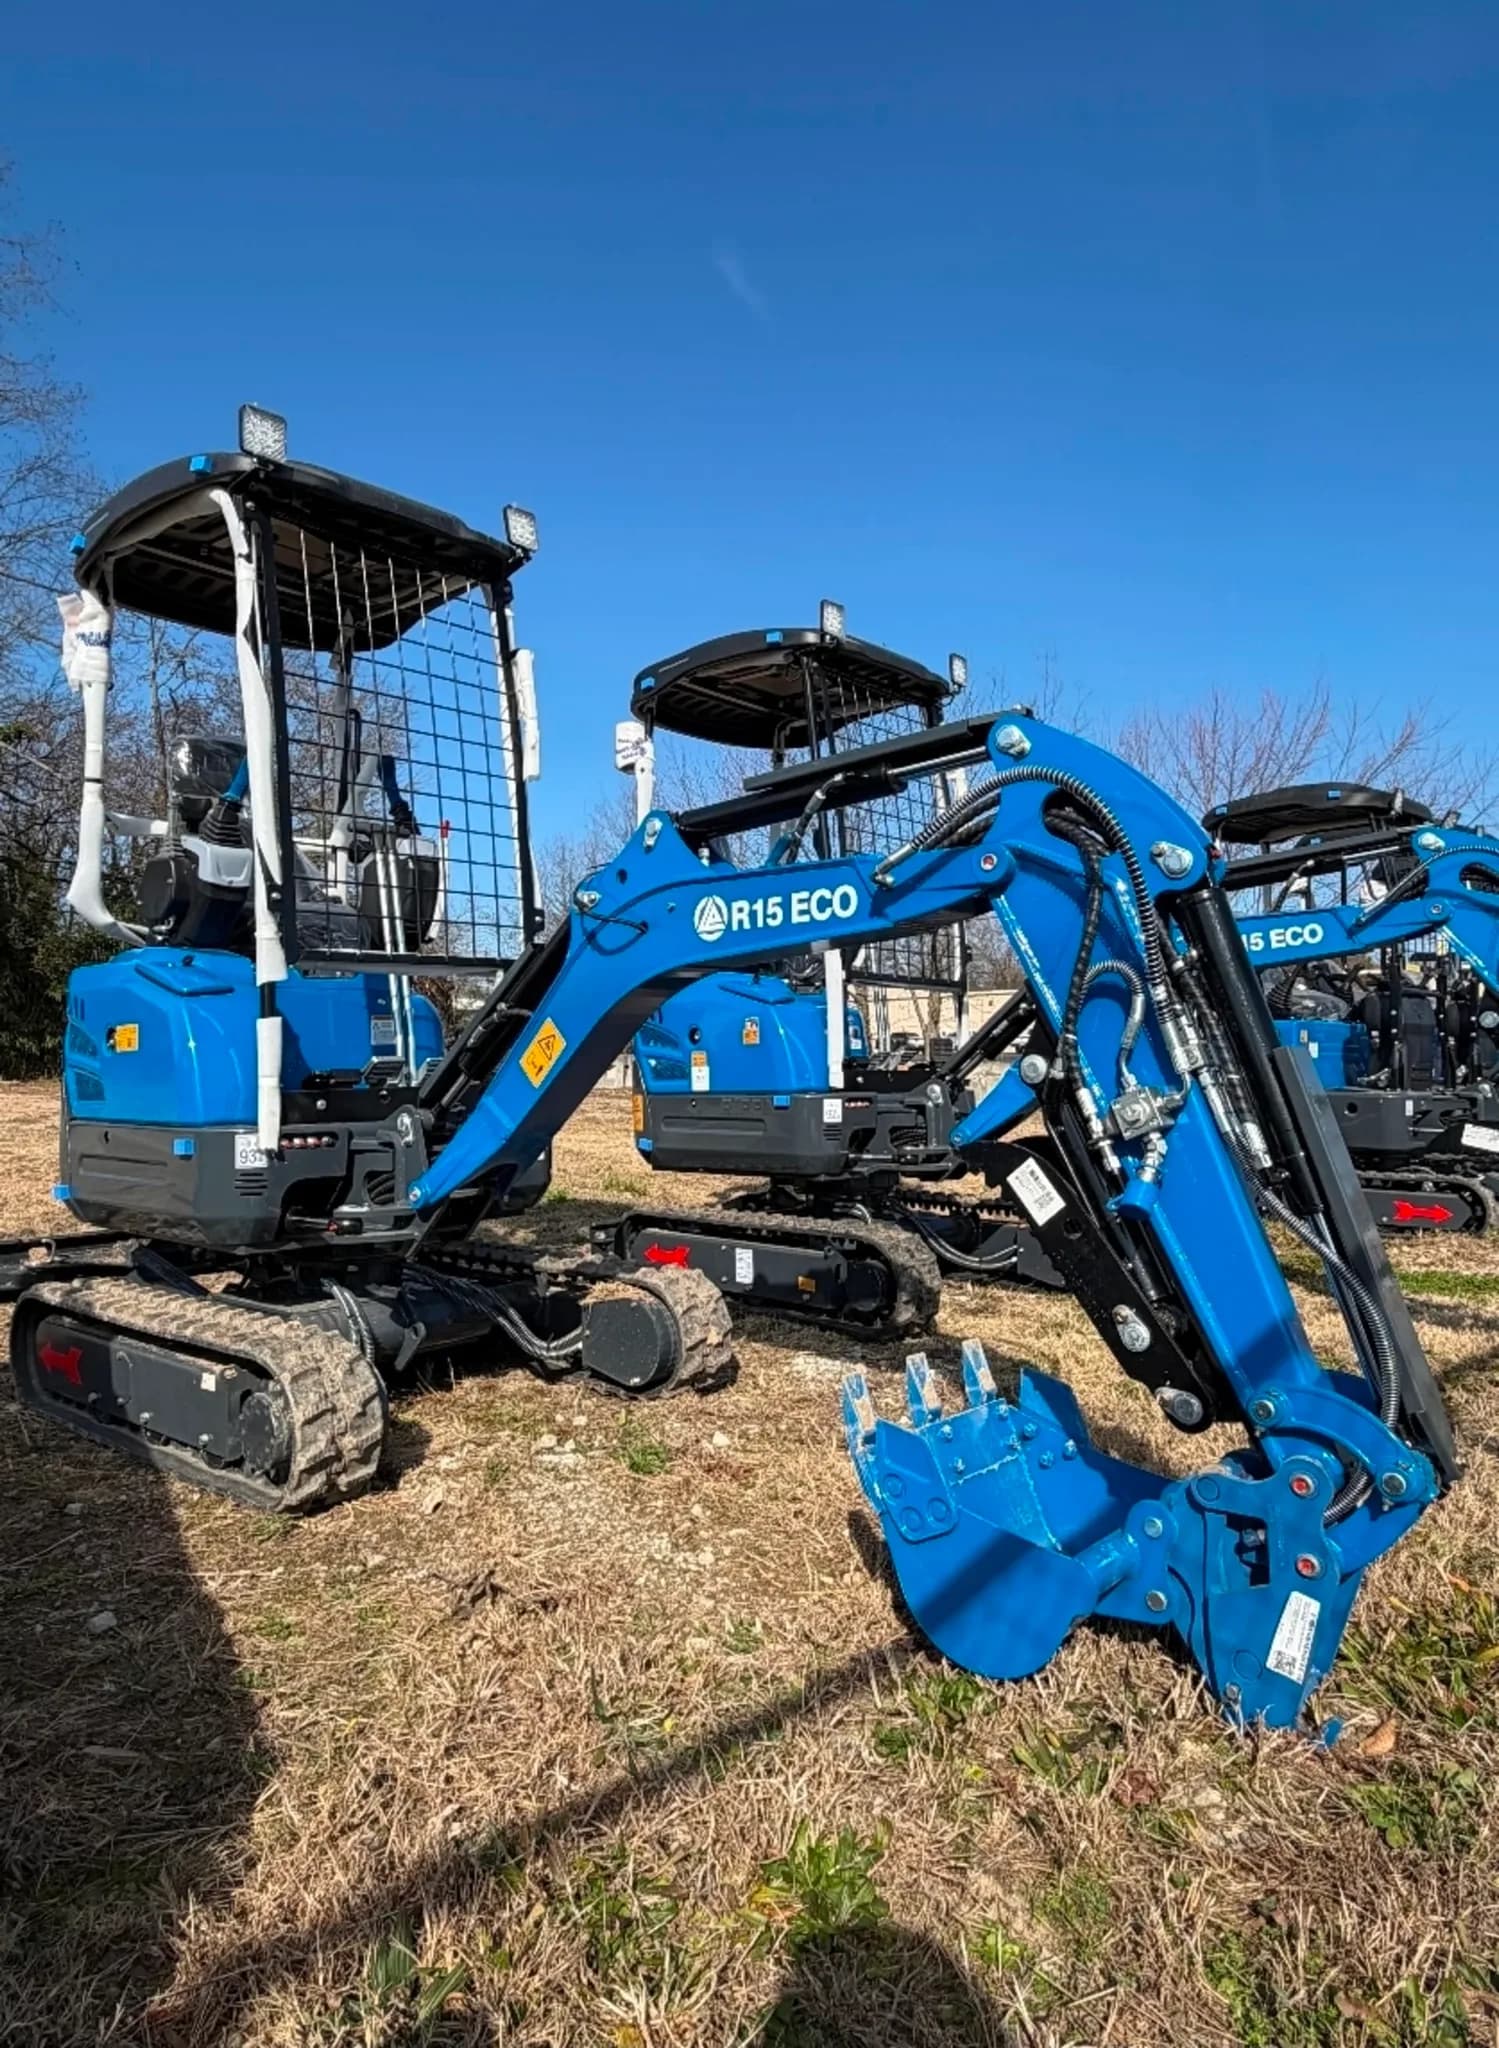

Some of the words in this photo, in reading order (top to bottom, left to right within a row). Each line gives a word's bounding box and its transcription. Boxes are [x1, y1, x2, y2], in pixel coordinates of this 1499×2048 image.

[731, 896, 783, 931] R15
[791, 884, 858, 924] ECO
[1269, 923, 1323, 949] ECO
